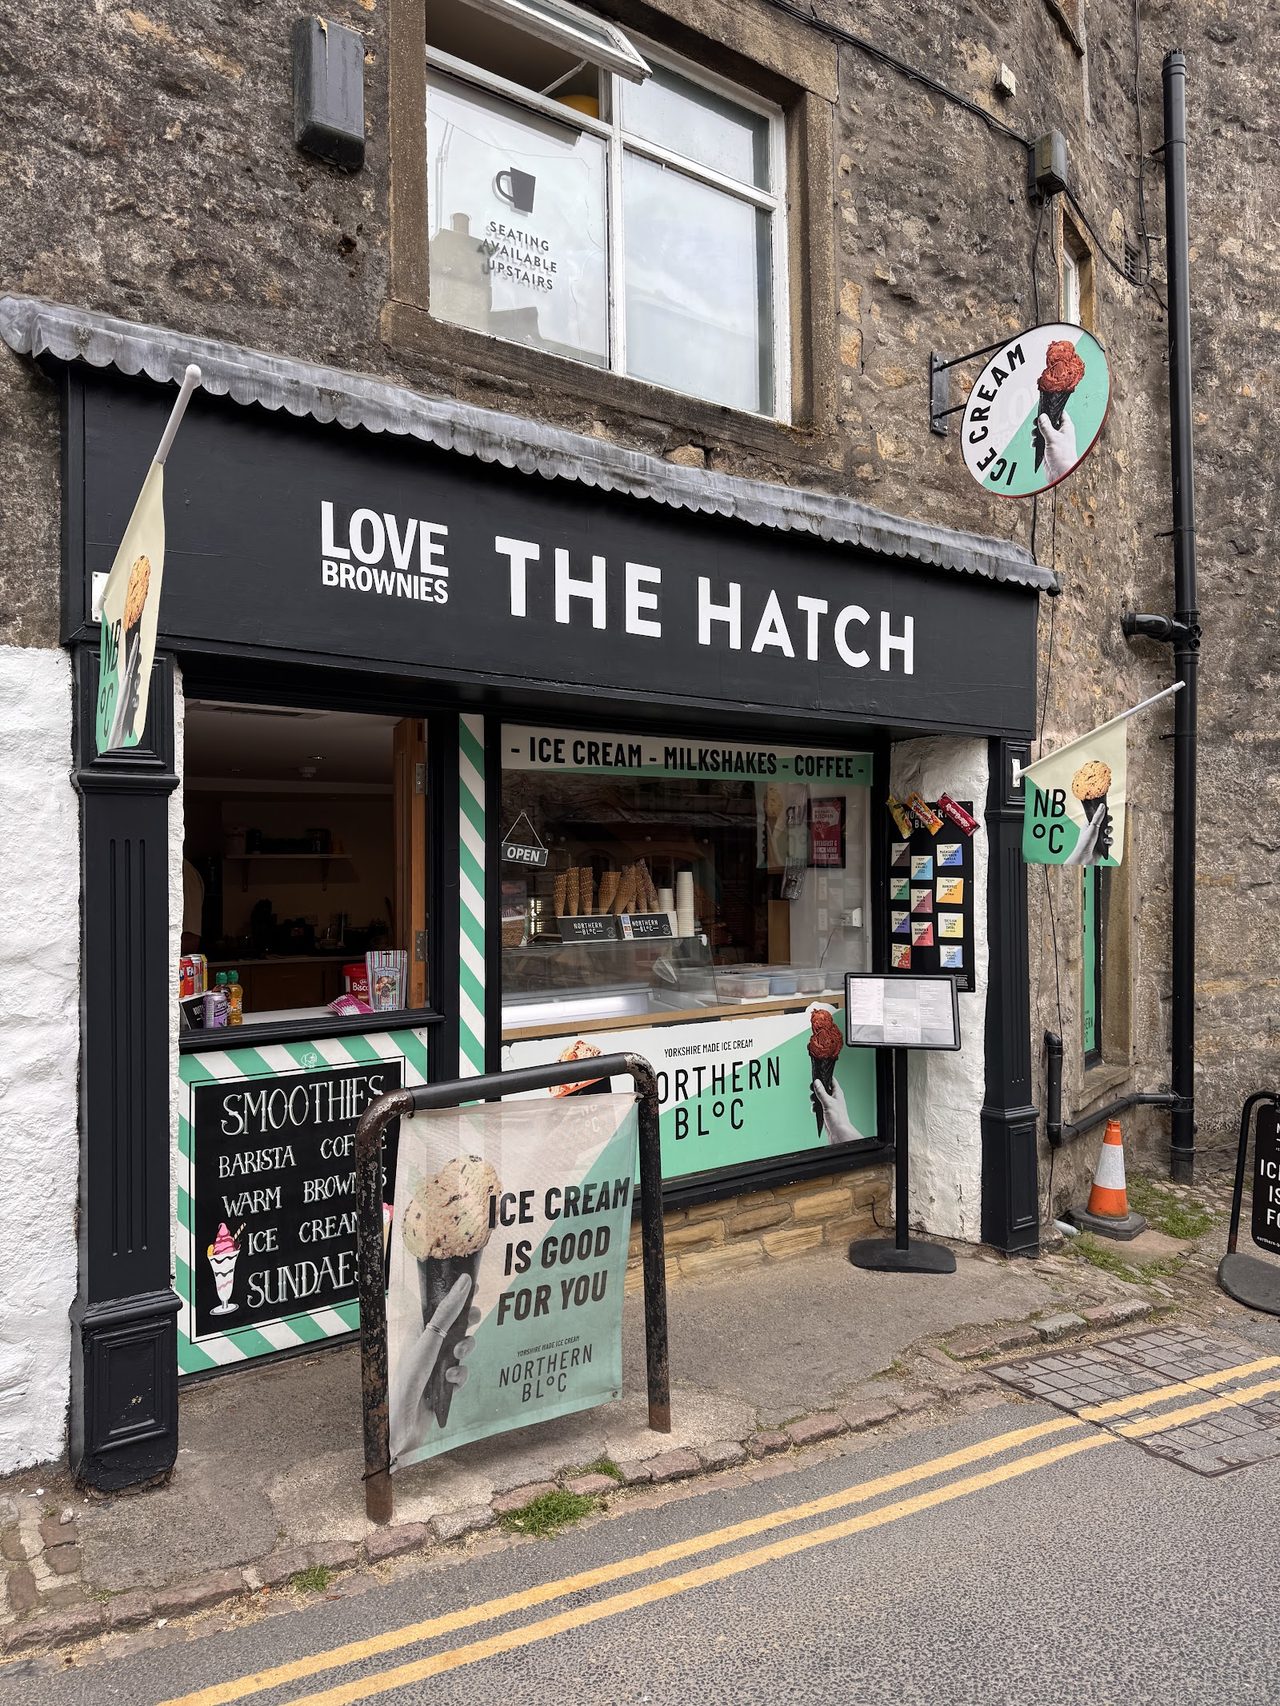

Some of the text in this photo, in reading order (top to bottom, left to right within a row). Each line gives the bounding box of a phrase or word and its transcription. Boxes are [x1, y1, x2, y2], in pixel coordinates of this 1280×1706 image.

[490, 221, 549, 251] SEATING
[482, 239, 557, 273] AVAILABLE
[488, 260, 553, 290] UPSTAIRS
[969, 343, 1026, 485] ICE CREAM
[321, 501, 449, 578] LOVE
[321, 560, 449, 604] BROWNIES
[495, 536, 914, 675] THE HATCH
[103, 618, 122, 676] NB
[529, 736, 565, 763] ICE
[573, 740, 642, 768] CREAM
[664, 747, 777, 775] MILKSHAKES
[794, 755, 854, 778] COFFEE
[1034, 789, 1066, 818] NB
[507, 846, 540, 862] OPEN
[574, 922, 602, 930] NORTHERN
[633, 919, 658, 927] NORTHERN
[664, 1039, 753, 1058] YORKSHIRE MADE ICE CREAM
[657, 1056, 780, 1104] ORTHERN
[218, 1145, 297, 1178] BARISTA
[1260, 1159, 1280, 1182] IC
[222, 1186, 282, 1218] WARM
[489, 1177, 630, 1228] ICE CREAM
[248, 1228, 279, 1256] ICE
[504, 1225, 610, 1276] IS GOOD
[497, 1270, 608, 1326] FOR YOU
[499, 1344, 593, 1388] NORTHERN
[517, 1344, 541, 1357] YORKSHIRE
[541, 1342, 555, 1353] MADE
